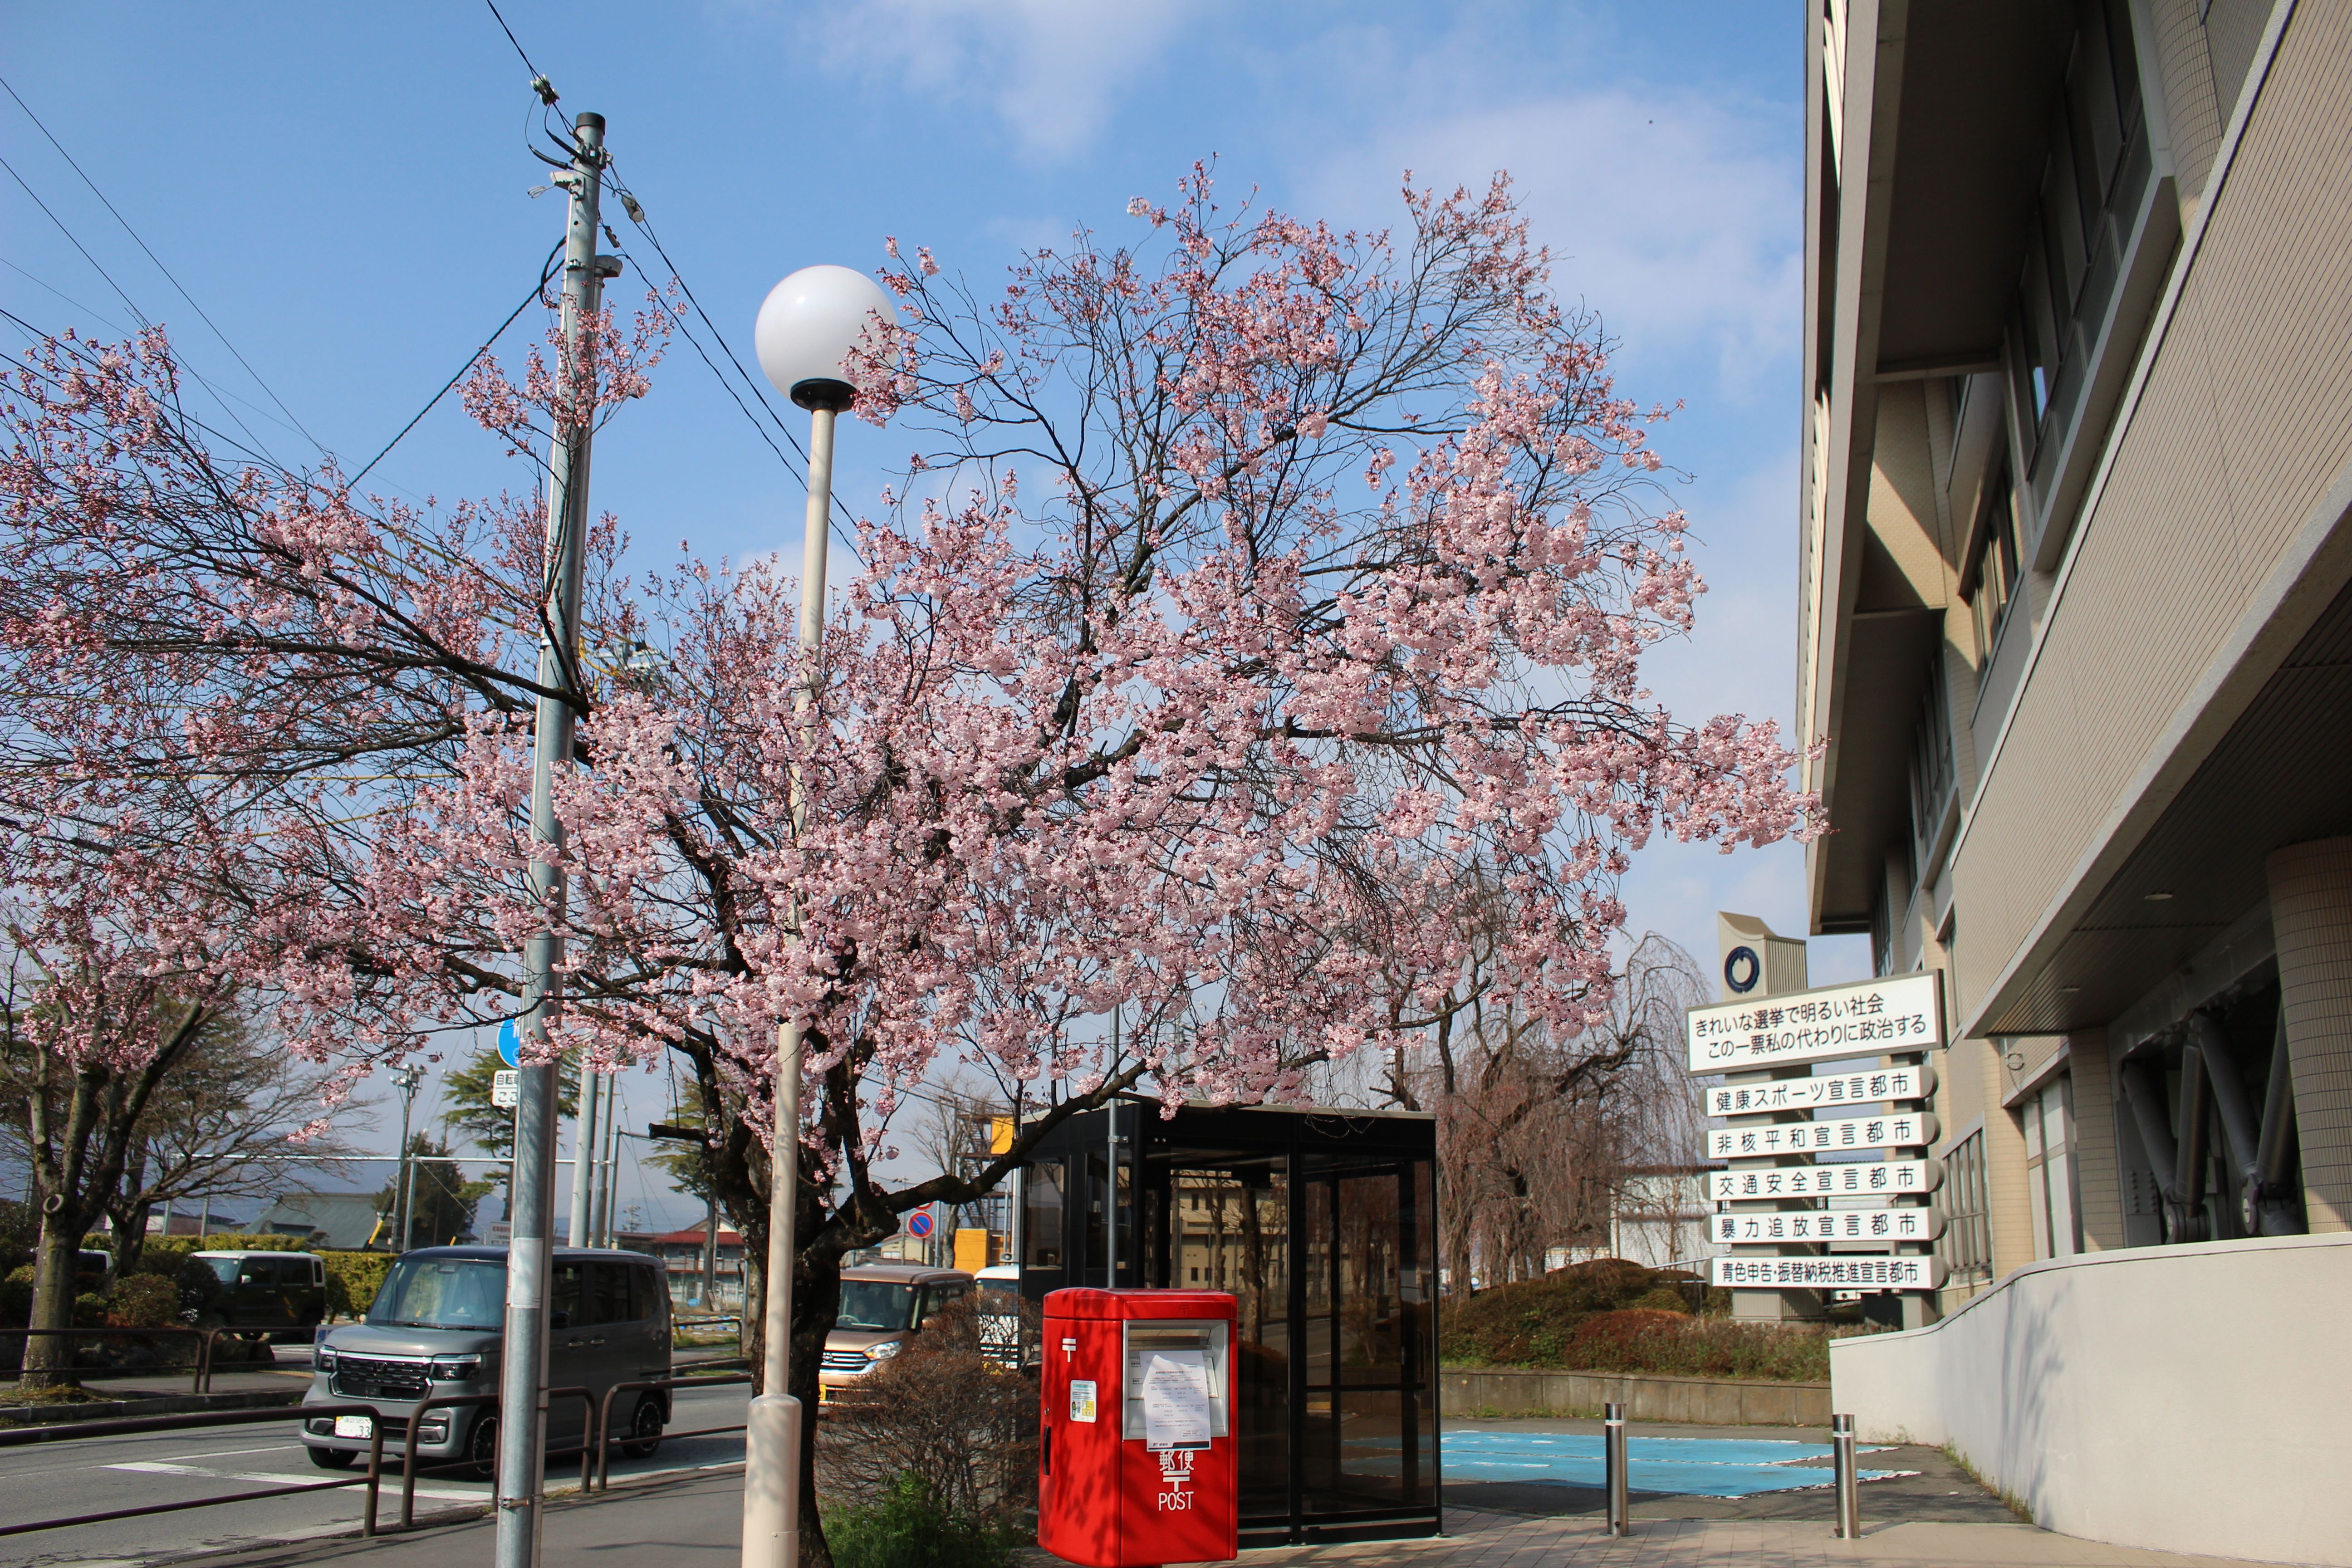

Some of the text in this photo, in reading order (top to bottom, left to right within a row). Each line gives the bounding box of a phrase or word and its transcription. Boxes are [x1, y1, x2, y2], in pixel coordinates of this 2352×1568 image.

[1696, 993, 1884, 1037] きれいな選挙で明るい社会
[1708, 1014, 1926, 1058] この一票私の代わりに政治する
[1716, 1073, 1909, 1111] 健康スポーツ宣言都市
[1717, 1119, 1911, 1154] 非核平和宣言都市
[1719, 1166, 1914, 1196] 交通安全宣言都市
[1720, 1212, 1916, 1239] 暴力追放宣言都市
[1159, 1450, 1195, 1471] 郵便
[1158, 1491, 1194, 1511] POST
